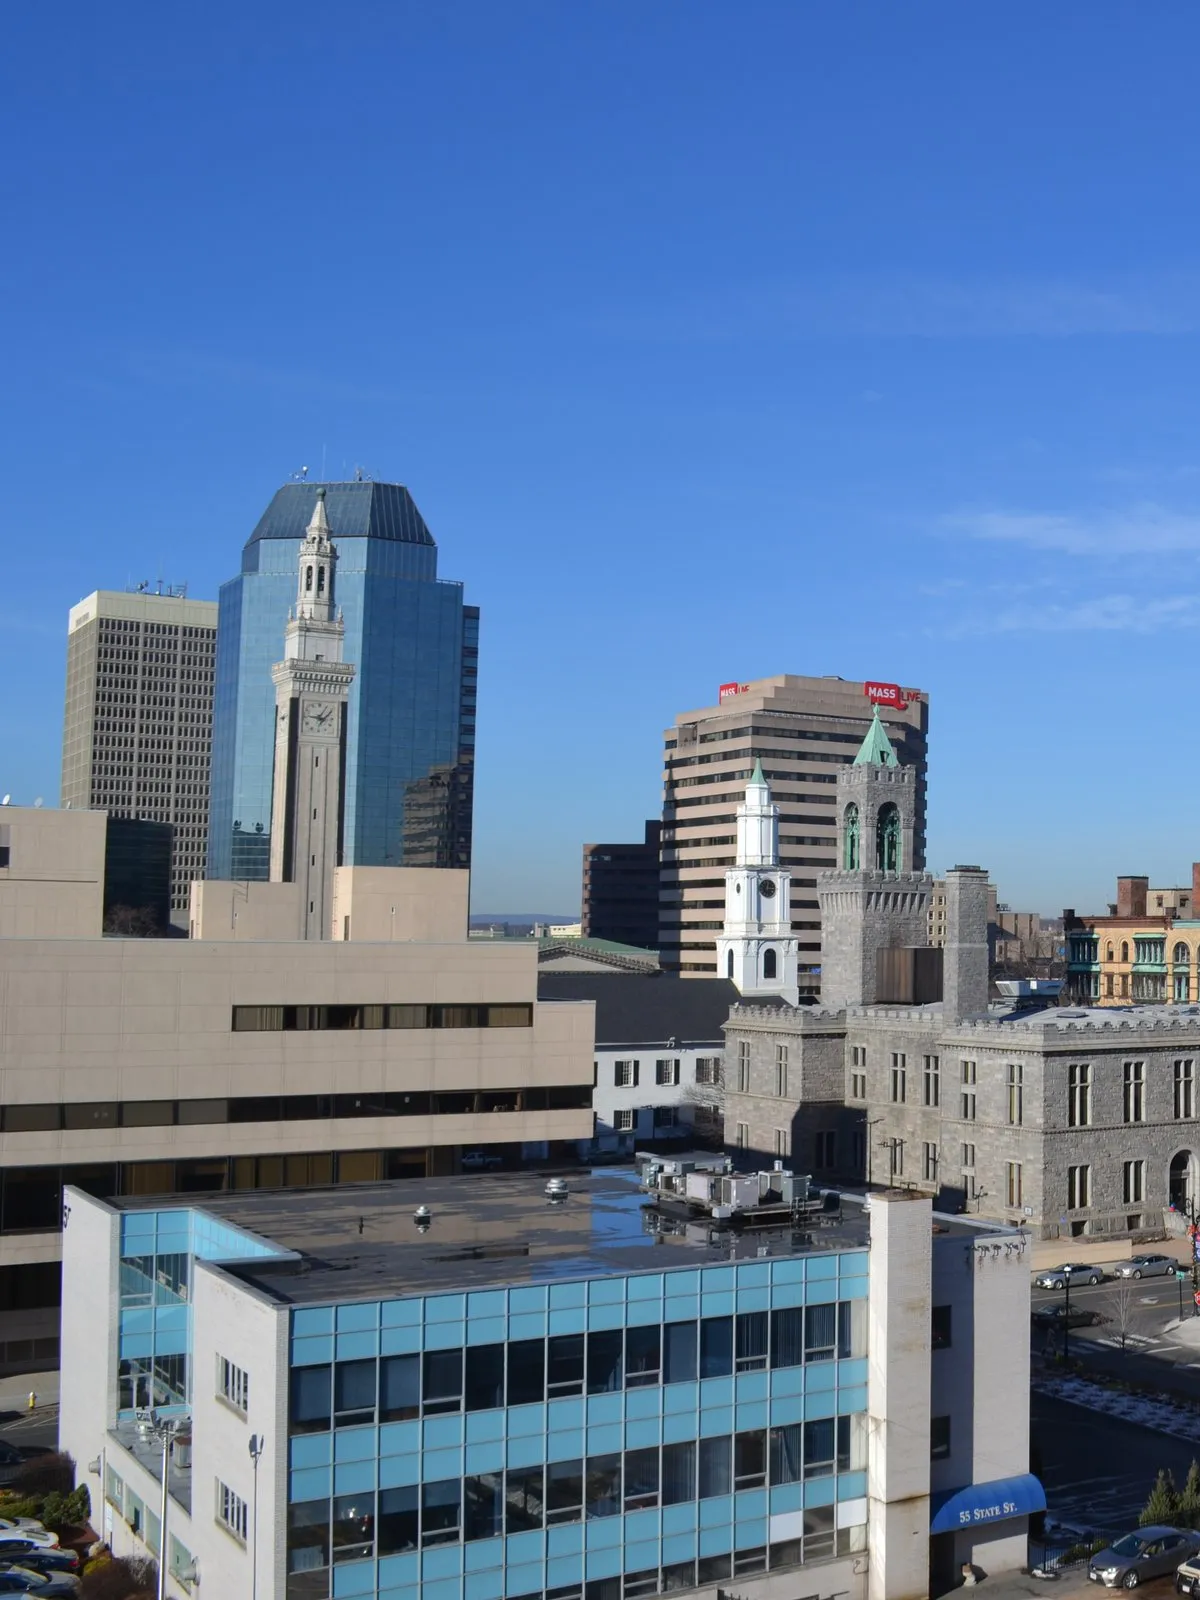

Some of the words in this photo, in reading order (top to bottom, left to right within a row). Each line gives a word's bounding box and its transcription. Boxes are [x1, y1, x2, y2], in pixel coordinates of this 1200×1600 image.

[868, 686, 896, 699] MASS
[901, 690, 921, 702] LIVE
[959, 1510, 971, 1523] 55
[973, 1506, 1001, 1521] STATE
